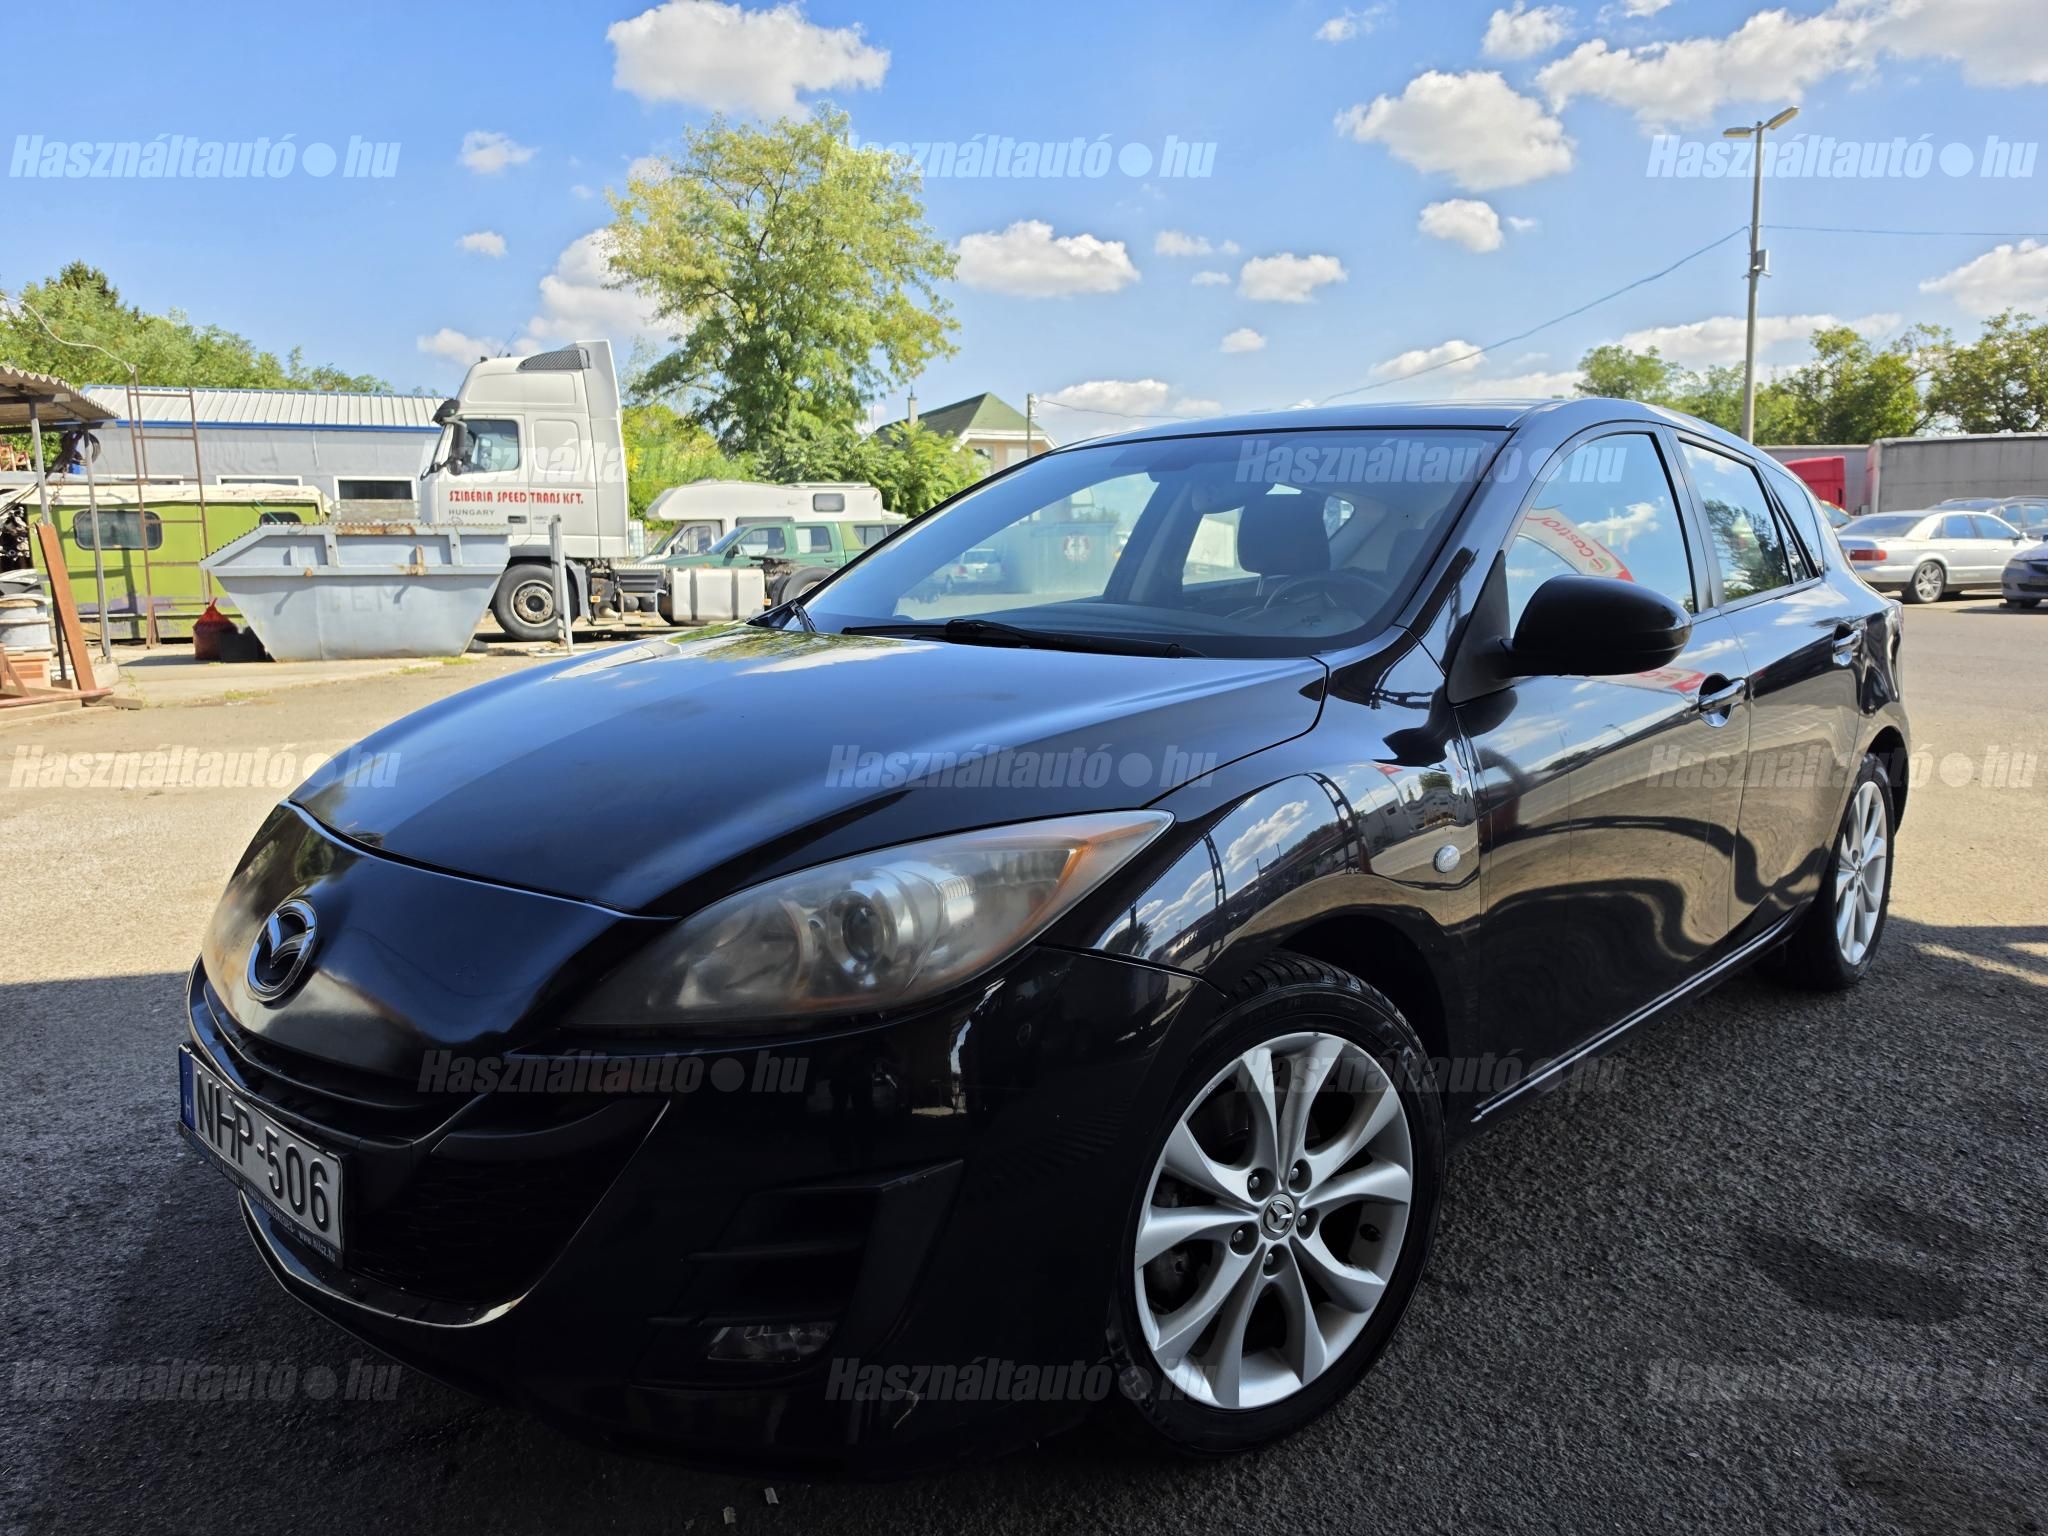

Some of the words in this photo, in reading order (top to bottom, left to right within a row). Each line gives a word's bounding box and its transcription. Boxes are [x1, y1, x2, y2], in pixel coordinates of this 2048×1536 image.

[497, 491, 527, 504] SPEED
[530, 492, 560, 504] TRANS
[449, 508, 495, 516] HUNGARY
[1526, 516, 1595, 558] Castrol
[196, 1069, 330, 1233] NHP-506
